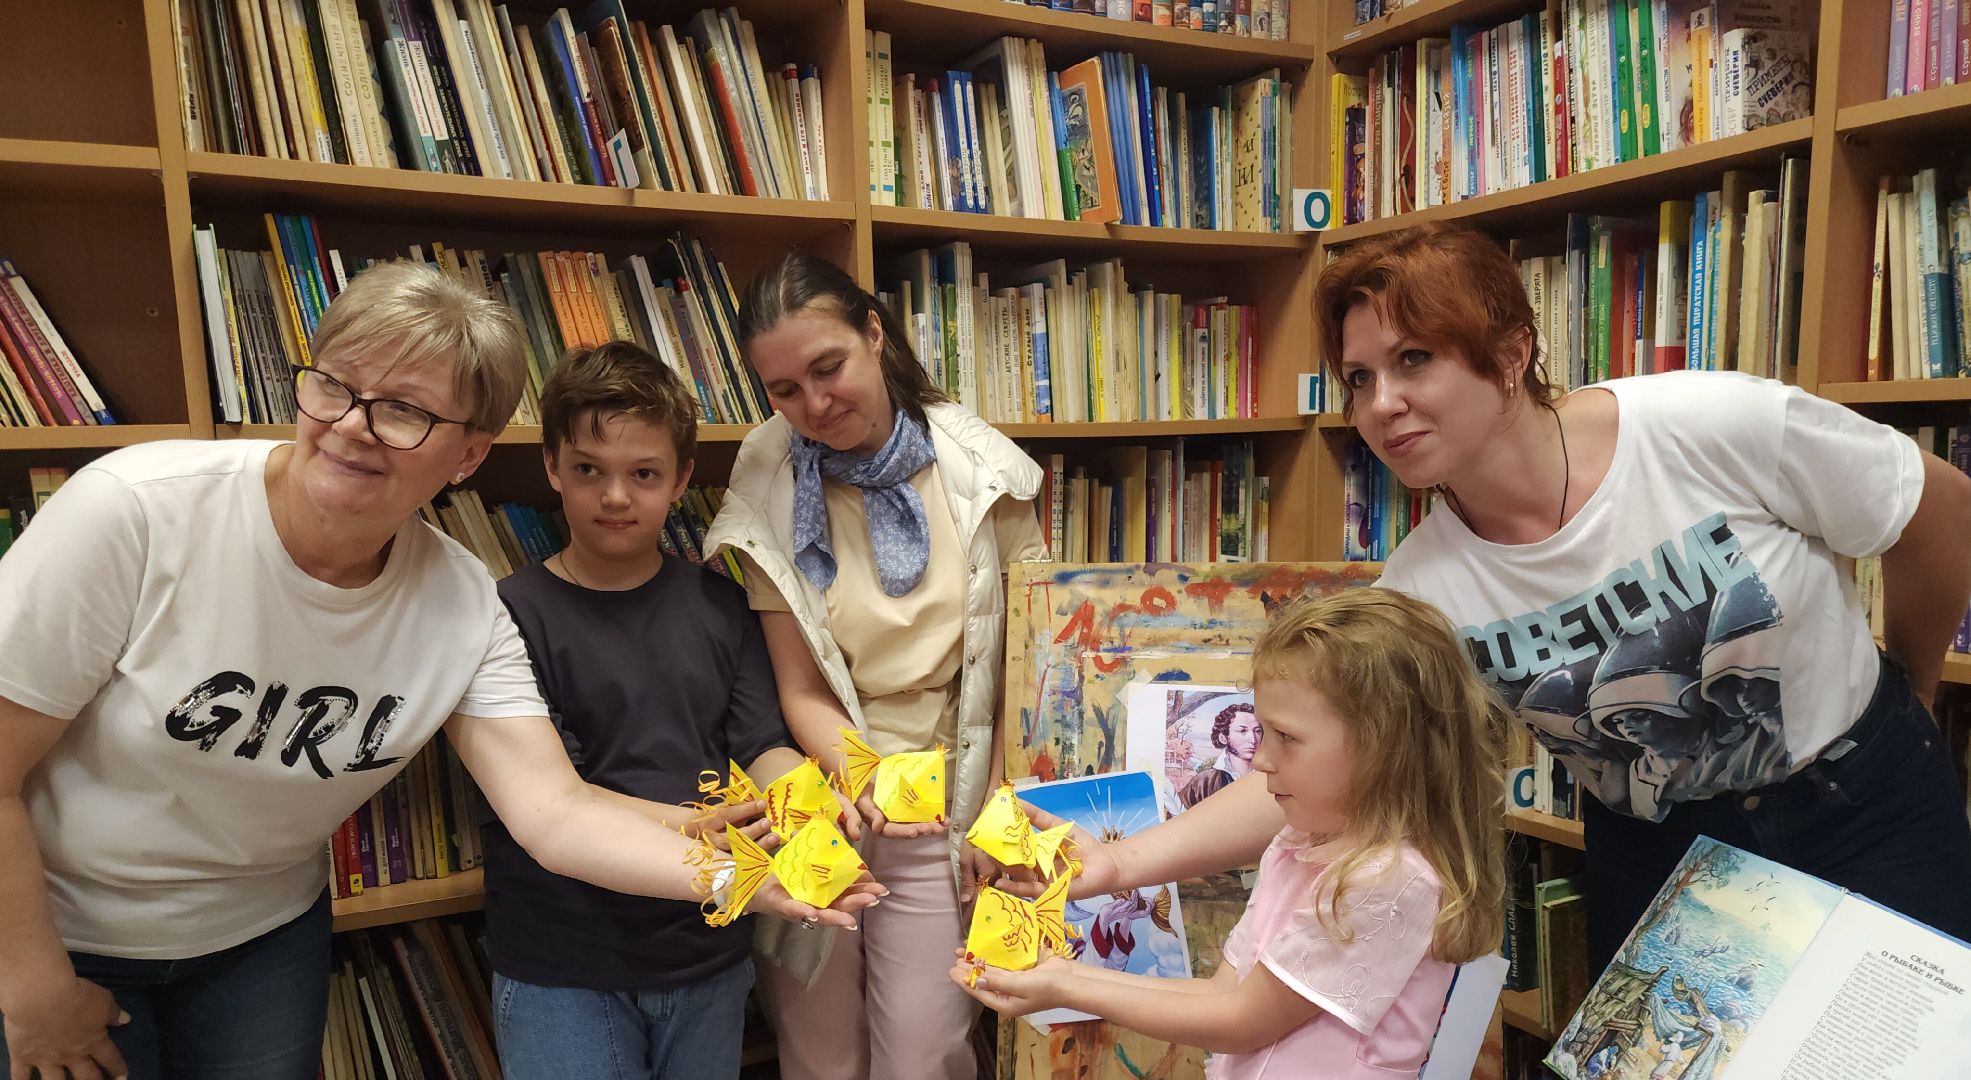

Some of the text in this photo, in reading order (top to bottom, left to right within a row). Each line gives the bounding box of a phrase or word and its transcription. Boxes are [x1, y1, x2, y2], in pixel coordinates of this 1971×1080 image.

[1304, 190, 1331, 230] О
[1461, 511, 1757, 683] СОВЕТСКИЕ
[166, 671, 405, 778] GIRL
[1881, 950, 1966, 996] О РЫБАКЕ И РЫБКЕ
[1910, 954, 1946, 976] СКАЗКА
